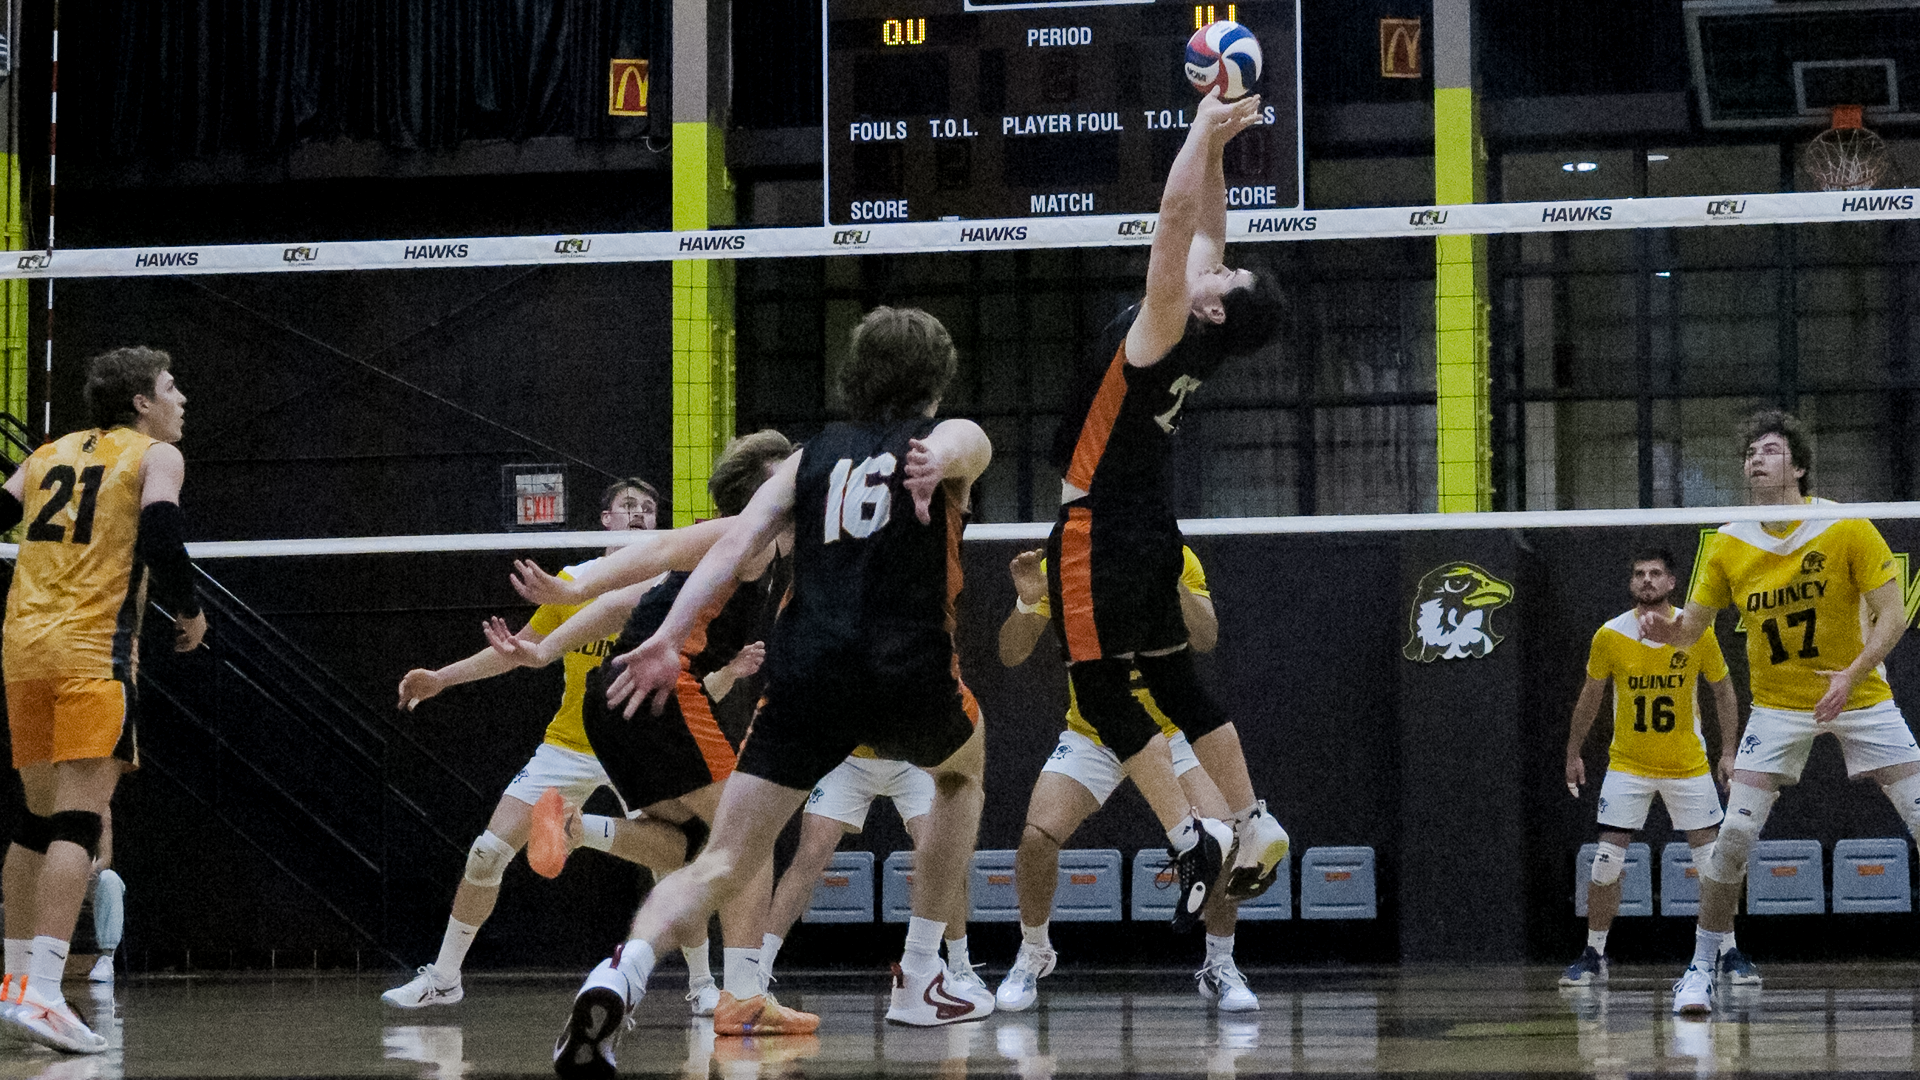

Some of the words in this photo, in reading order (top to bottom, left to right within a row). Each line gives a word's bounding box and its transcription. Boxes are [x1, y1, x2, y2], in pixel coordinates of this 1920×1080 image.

[1027, 26, 1092, 47] PERIOD
[850, 121, 907, 141] FOULS
[929, 119, 979, 138] T.O.L.
[1002, 114, 1071, 135] PLAYER
[1077, 112, 1124, 132] FOUL
[1030, 192, 1094, 213] MATCH
[1224, 186, 1277, 206] CORE
[850, 200, 908, 220] SCORE
[135, 252, 199, 268] HAWKS
[404, 244, 469, 260] HAWKS
[679, 235, 745, 251] HAWKS
[960, 226, 1028, 242] HAWKS
[1248, 217, 1317, 233] HAWKS
[1541, 206, 1613, 223] HAWKS
[1842, 195, 1914, 212] HAWKS
[26, 465, 106, 545] 21
[523, 496, 556, 521] EXIT
[824, 452, 897, 544] 16
[1747, 580, 1828, 613] QUINCY
[1761, 607, 1820, 665] 17
[1628, 674, 1686, 690] QUINCY
[1633, 695, 1676, 733] 16
